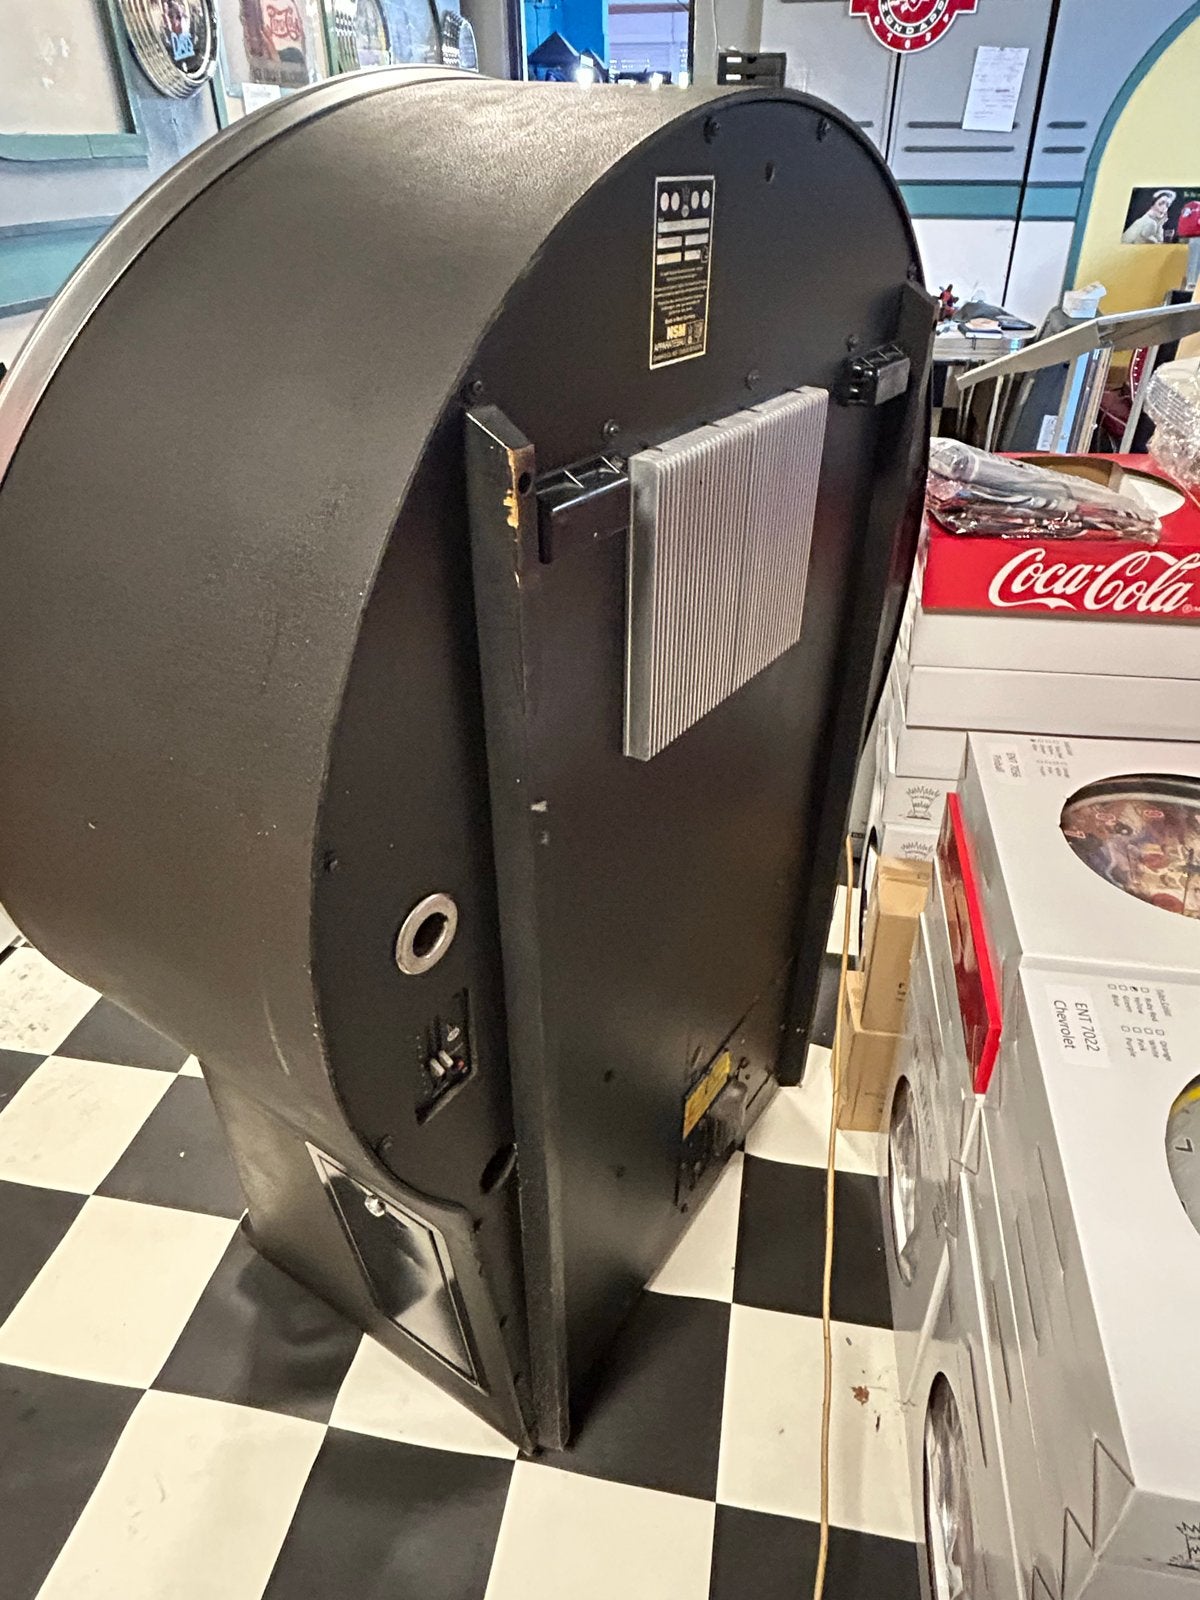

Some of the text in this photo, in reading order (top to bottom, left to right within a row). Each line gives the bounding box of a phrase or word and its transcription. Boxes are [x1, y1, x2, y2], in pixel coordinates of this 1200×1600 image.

[988, 547, 1200, 613] Coca-Cola
[1053, 1000, 1076, 1049] Chevrolet
[1075, 1002, 1100, 1052] ENT 7022
